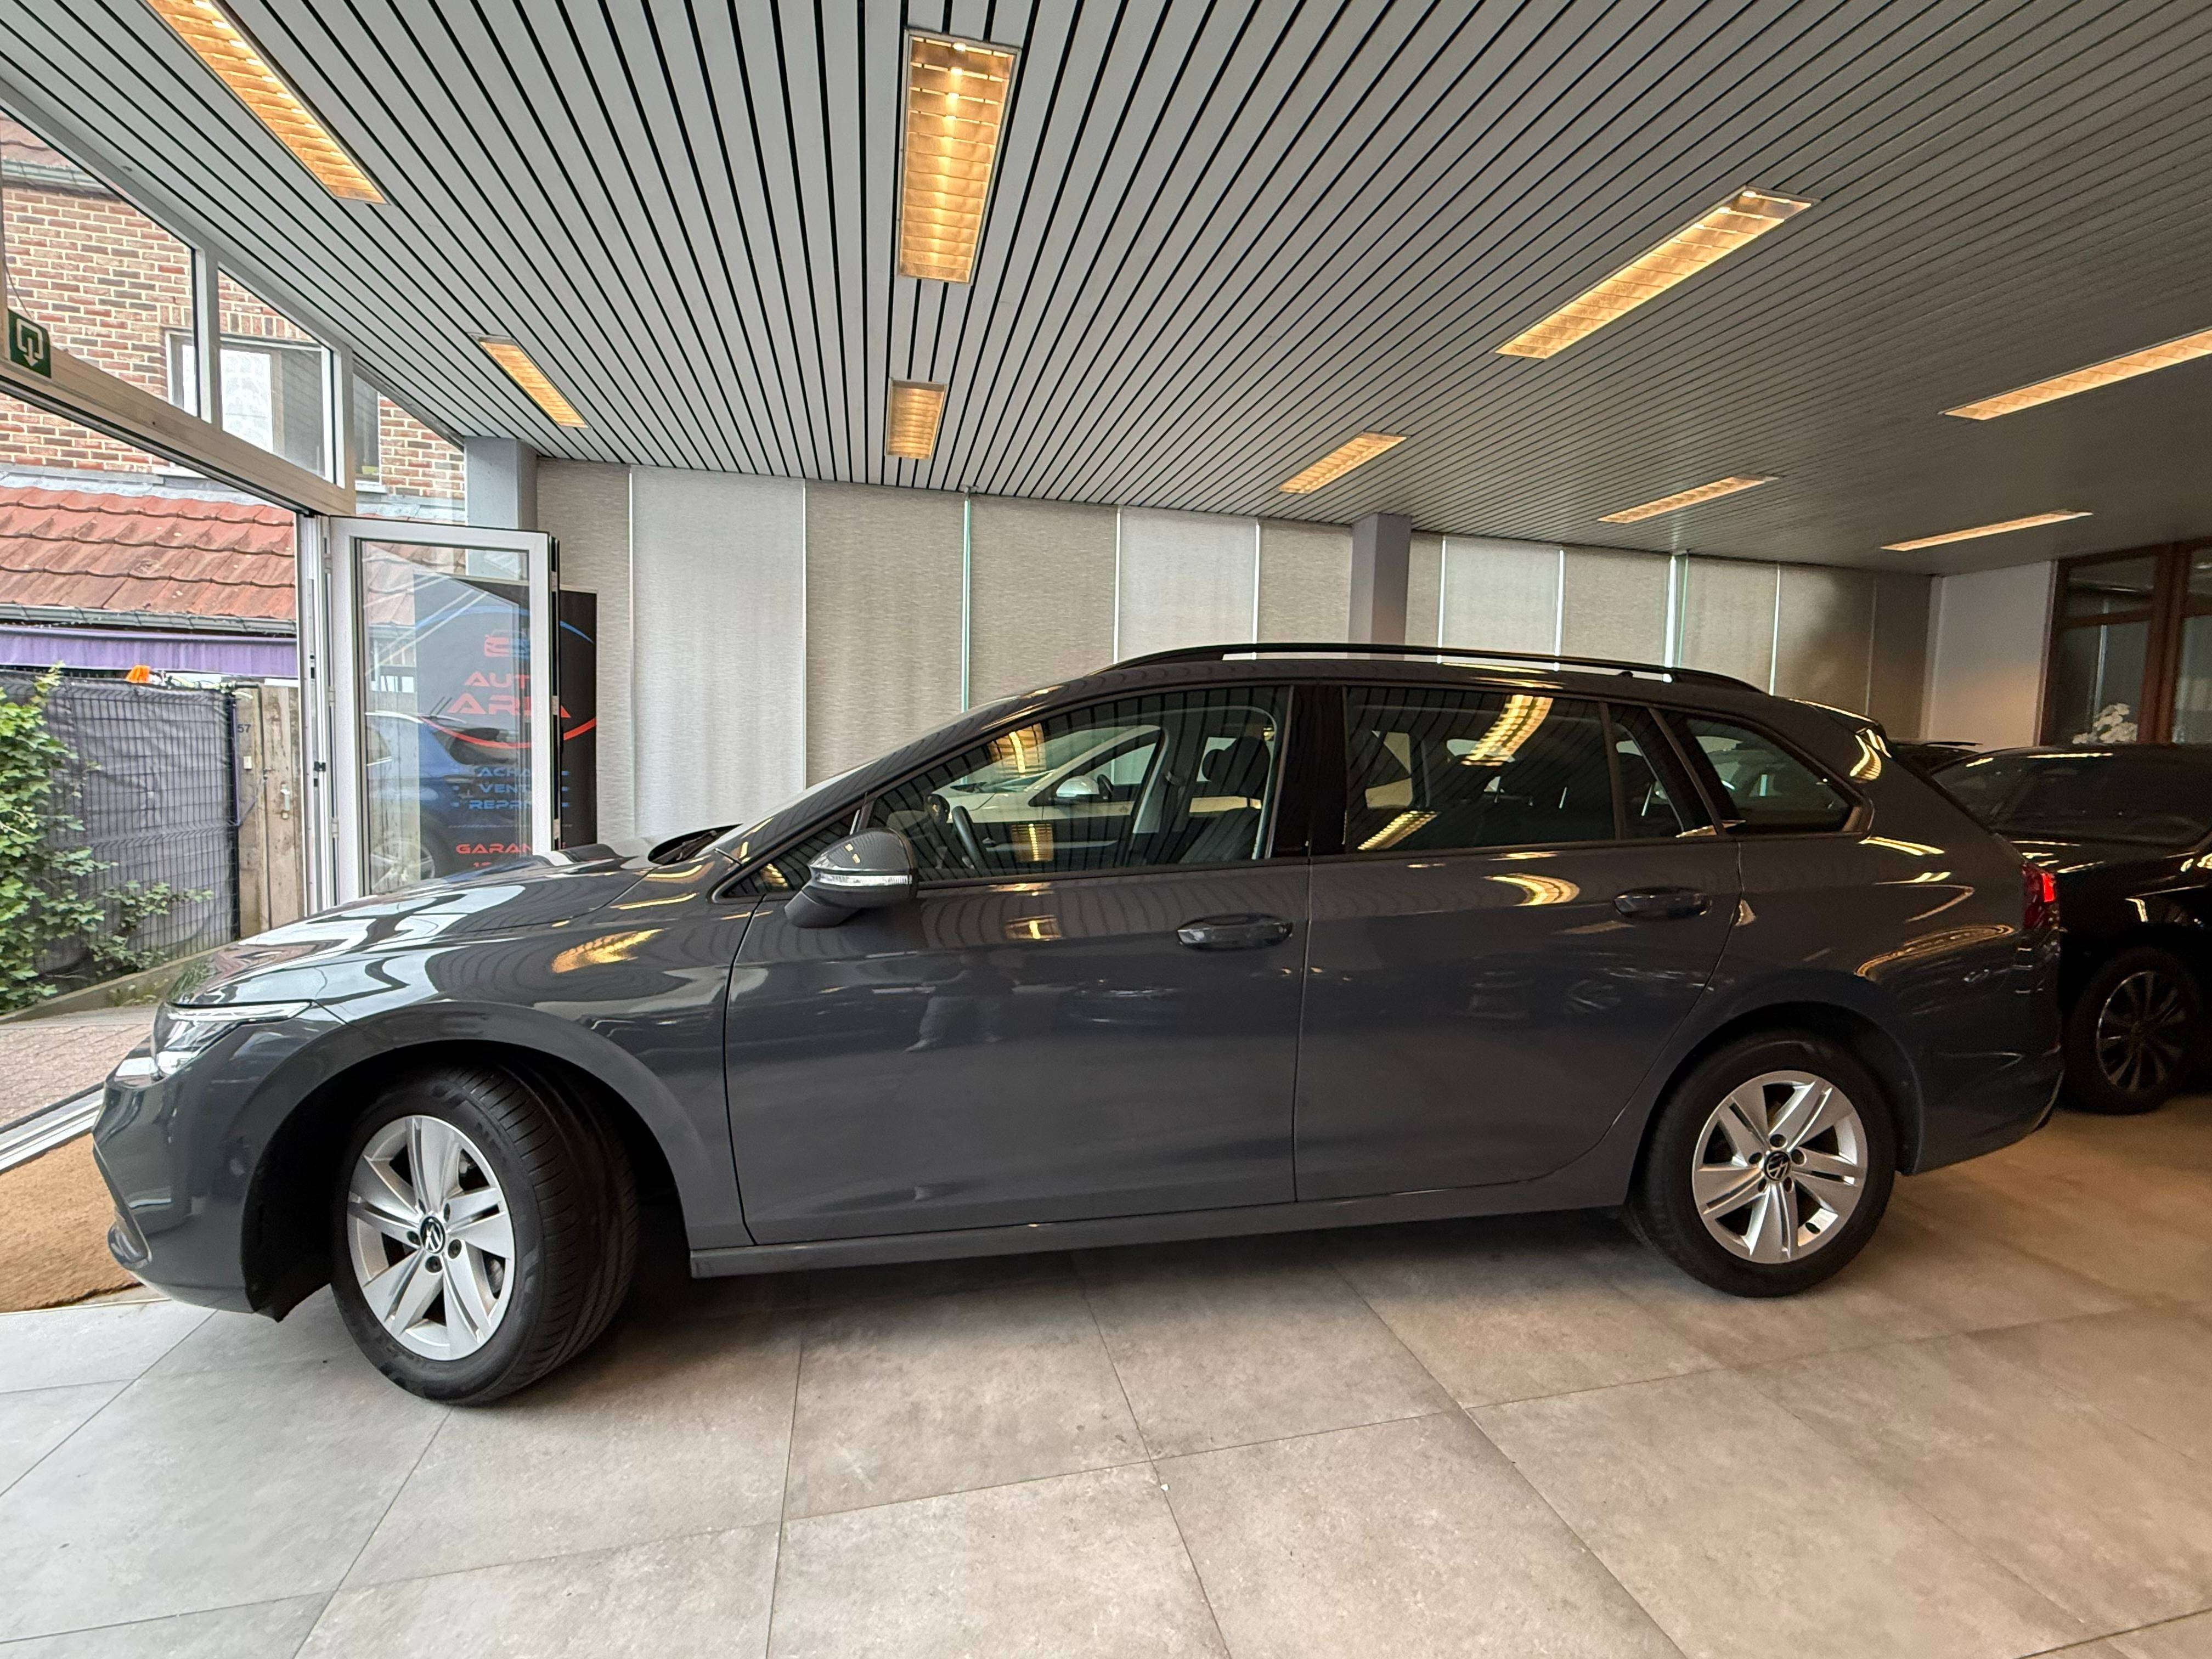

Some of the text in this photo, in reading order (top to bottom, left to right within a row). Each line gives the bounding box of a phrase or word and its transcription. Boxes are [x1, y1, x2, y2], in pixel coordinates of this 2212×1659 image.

[465, 670, 531, 689] AUT
[237, 724, 251, 733] 57
[478, 767, 531, 777] ACHA
[478, 783, 531, 793] VENT
[456, 843, 566, 854] GARAN
